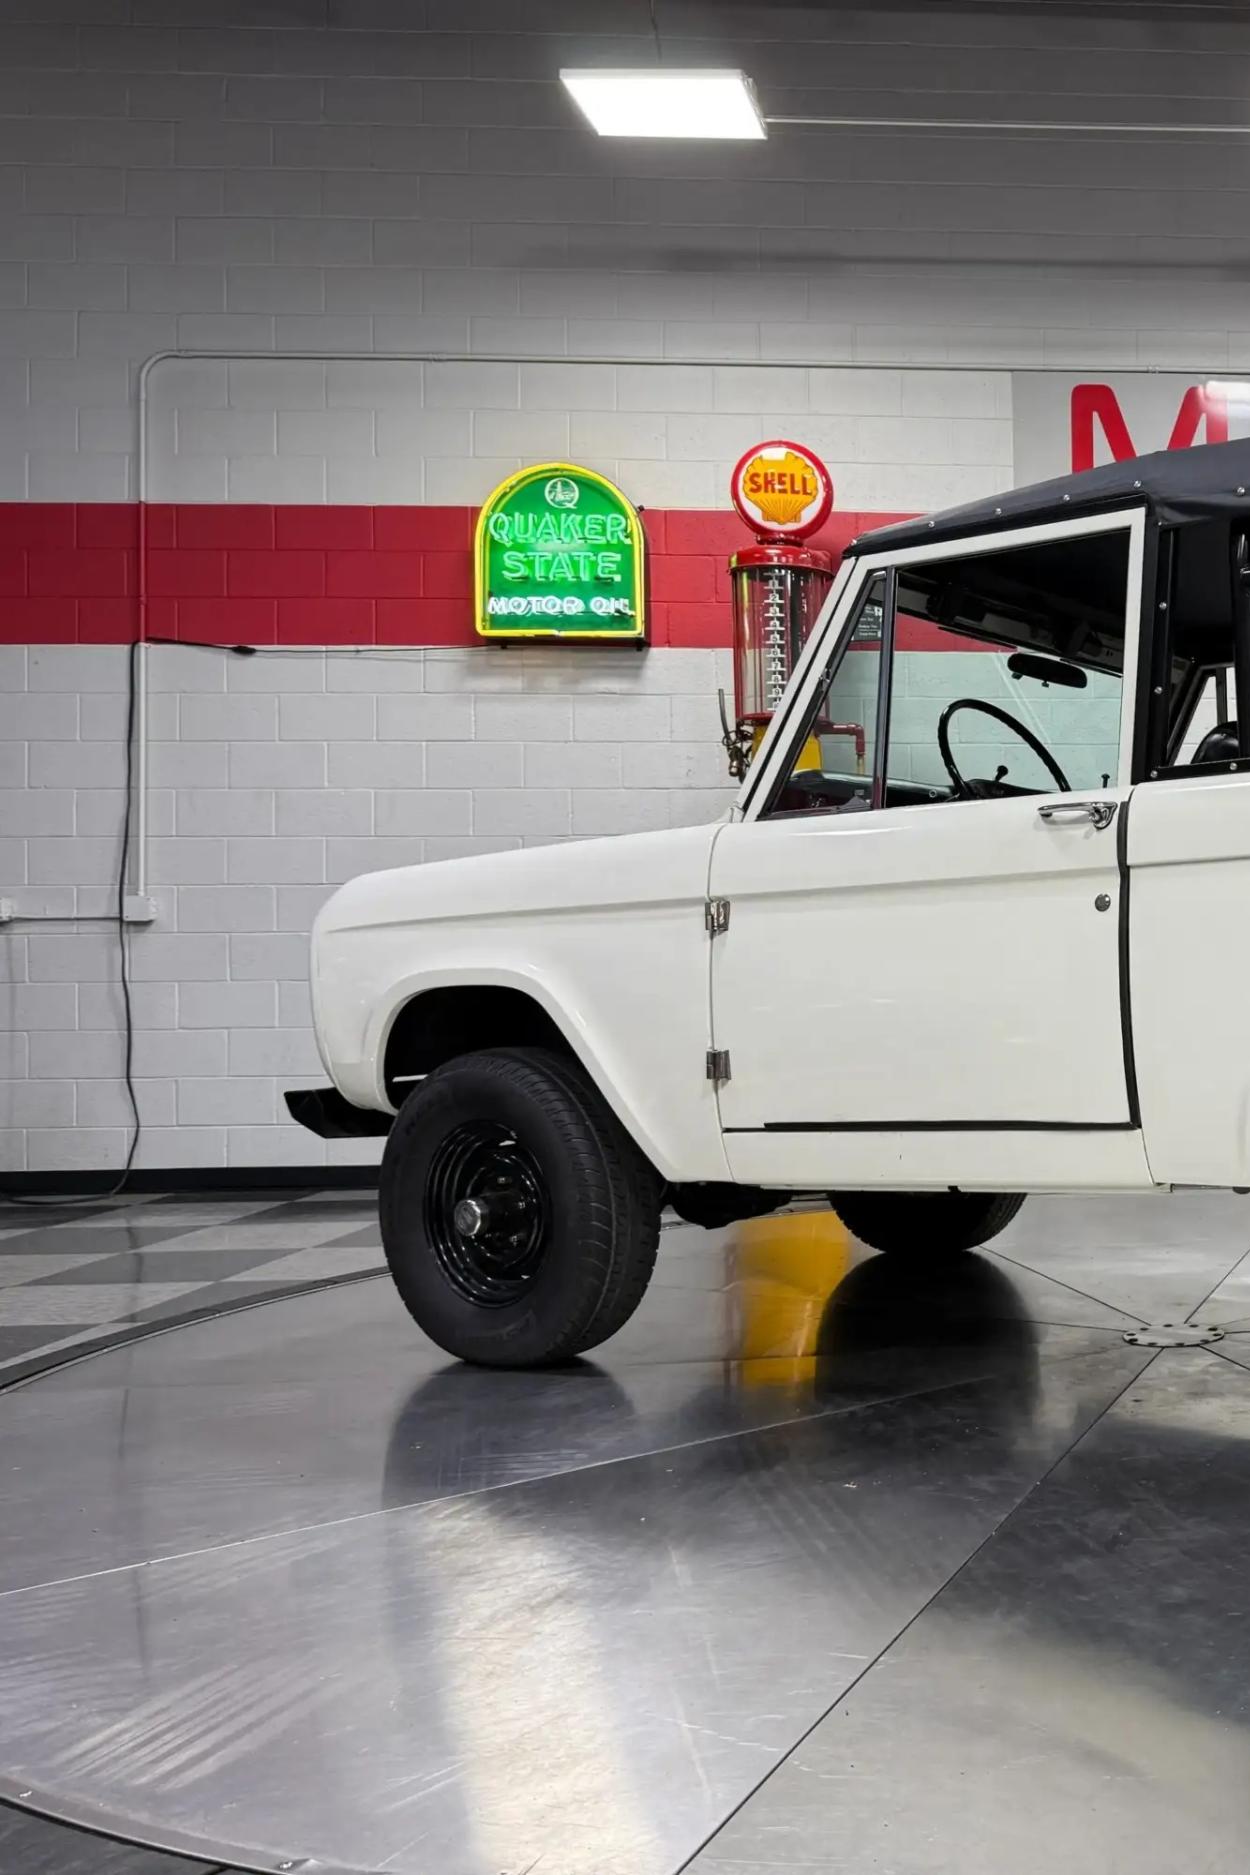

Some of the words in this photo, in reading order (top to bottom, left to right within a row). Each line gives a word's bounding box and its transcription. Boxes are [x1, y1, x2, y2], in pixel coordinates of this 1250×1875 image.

[749, 472, 813, 496] SHELL
[488, 512, 633, 547] QUAKER
[502, 551, 622, 582] STATE
[488, 596, 585, 616] MOTOR
[590, 596, 636, 616] OIL
